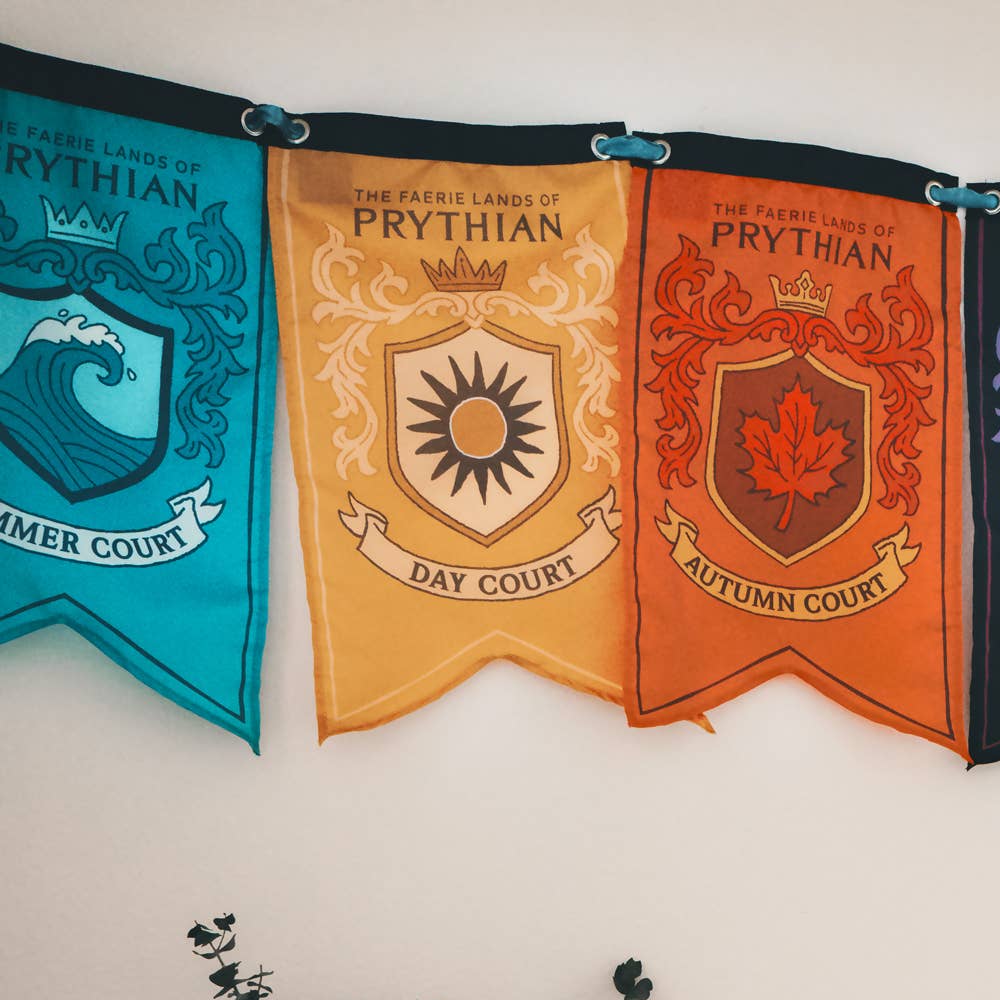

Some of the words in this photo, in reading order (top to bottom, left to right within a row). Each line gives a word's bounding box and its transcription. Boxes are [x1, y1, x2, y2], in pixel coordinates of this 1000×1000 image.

[27, 126, 94, 152] FAERIE
[104, 143, 167, 169] LANDS
[176, 159, 200, 175] OF
[4, 142, 197, 213] RYTHIAN
[354, 189, 391, 202] THE
[400, 190, 464, 205] FAERIE
[473, 193, 533, 207] LANDS
[540, 193, 560, 206] OF
[353, 207, 563, 242] PRYTHIAN
[714, 203, 748, 216] THE
[756, 205, 816, 223] FAERIE
[823, 213, 866, 236] LANDS
[874, 224, 895, 238] OF
[711, 221, 892, 272] PRYTHIAN
[91, 525, 188, 559] COURT
[409, 560, 467, 593] DAY
[478, 555, 577, 595] COURT
[684, 556, 795, 613] AUTUMN
[804, 572, 887, 614] COURT
